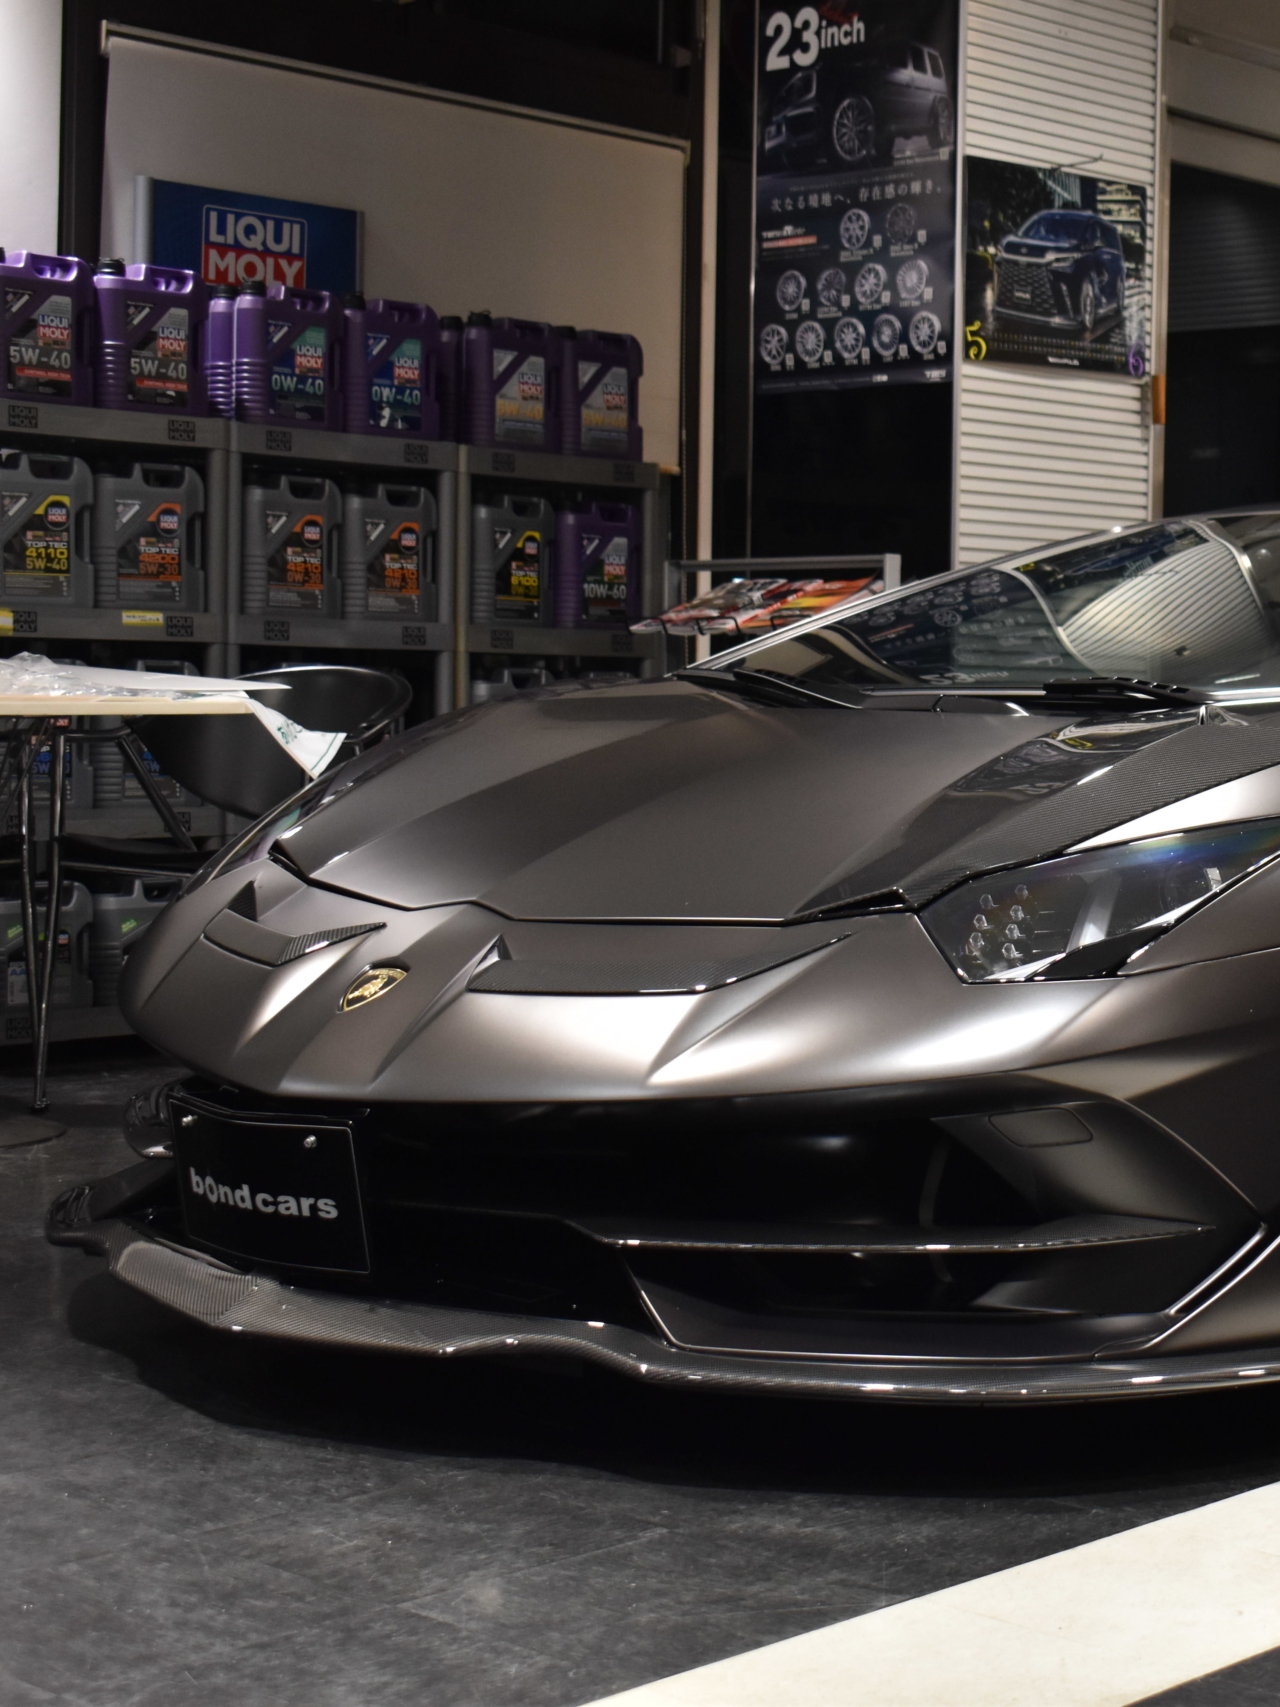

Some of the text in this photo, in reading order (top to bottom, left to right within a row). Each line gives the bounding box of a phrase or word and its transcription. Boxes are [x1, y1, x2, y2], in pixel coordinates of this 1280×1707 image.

[209, 210, 301, 255] LIQUI
[208, 248, 304, 289] MOLY
[39, 315, 69, 328] LIQUI
[39, 326, 70, 339] MOLY
[159, 327, 186, 340] LIQUI
[159, 339, 187, 351] MOLY
[966, 320, 988, 361] 5
[296, 345, 323, 356] LIQUI
[10, 346, 71, 369] 5W-40
[296, 355, 323, 368] MOLY
[395, 357, 419, 368] LIQUI
[130, 358, 187, 380] 5W-40
[395, 367, 420, 379] MOLY
[272, 375, 324, 395] 0W-40
[371, 384, 421, 406] 0W-40
[10, 406, 37, 417] LIQUI
[10, 416, 37, 427] MOLY
[170, 421, 195, 431] LIQUI
[170, 430, 195, 442] MOLY
[26, 541, 47, 549] TOP
[25, 548, 68, 559] 4110
[26, 558, 68, 570] 5W-40
[583, 582, 627, 600] 10W-60
[14, 612, 36, 622] IQUI
[168, 618, 193, 627] LIQUI
[168, 626, 193, 636] MOLY
